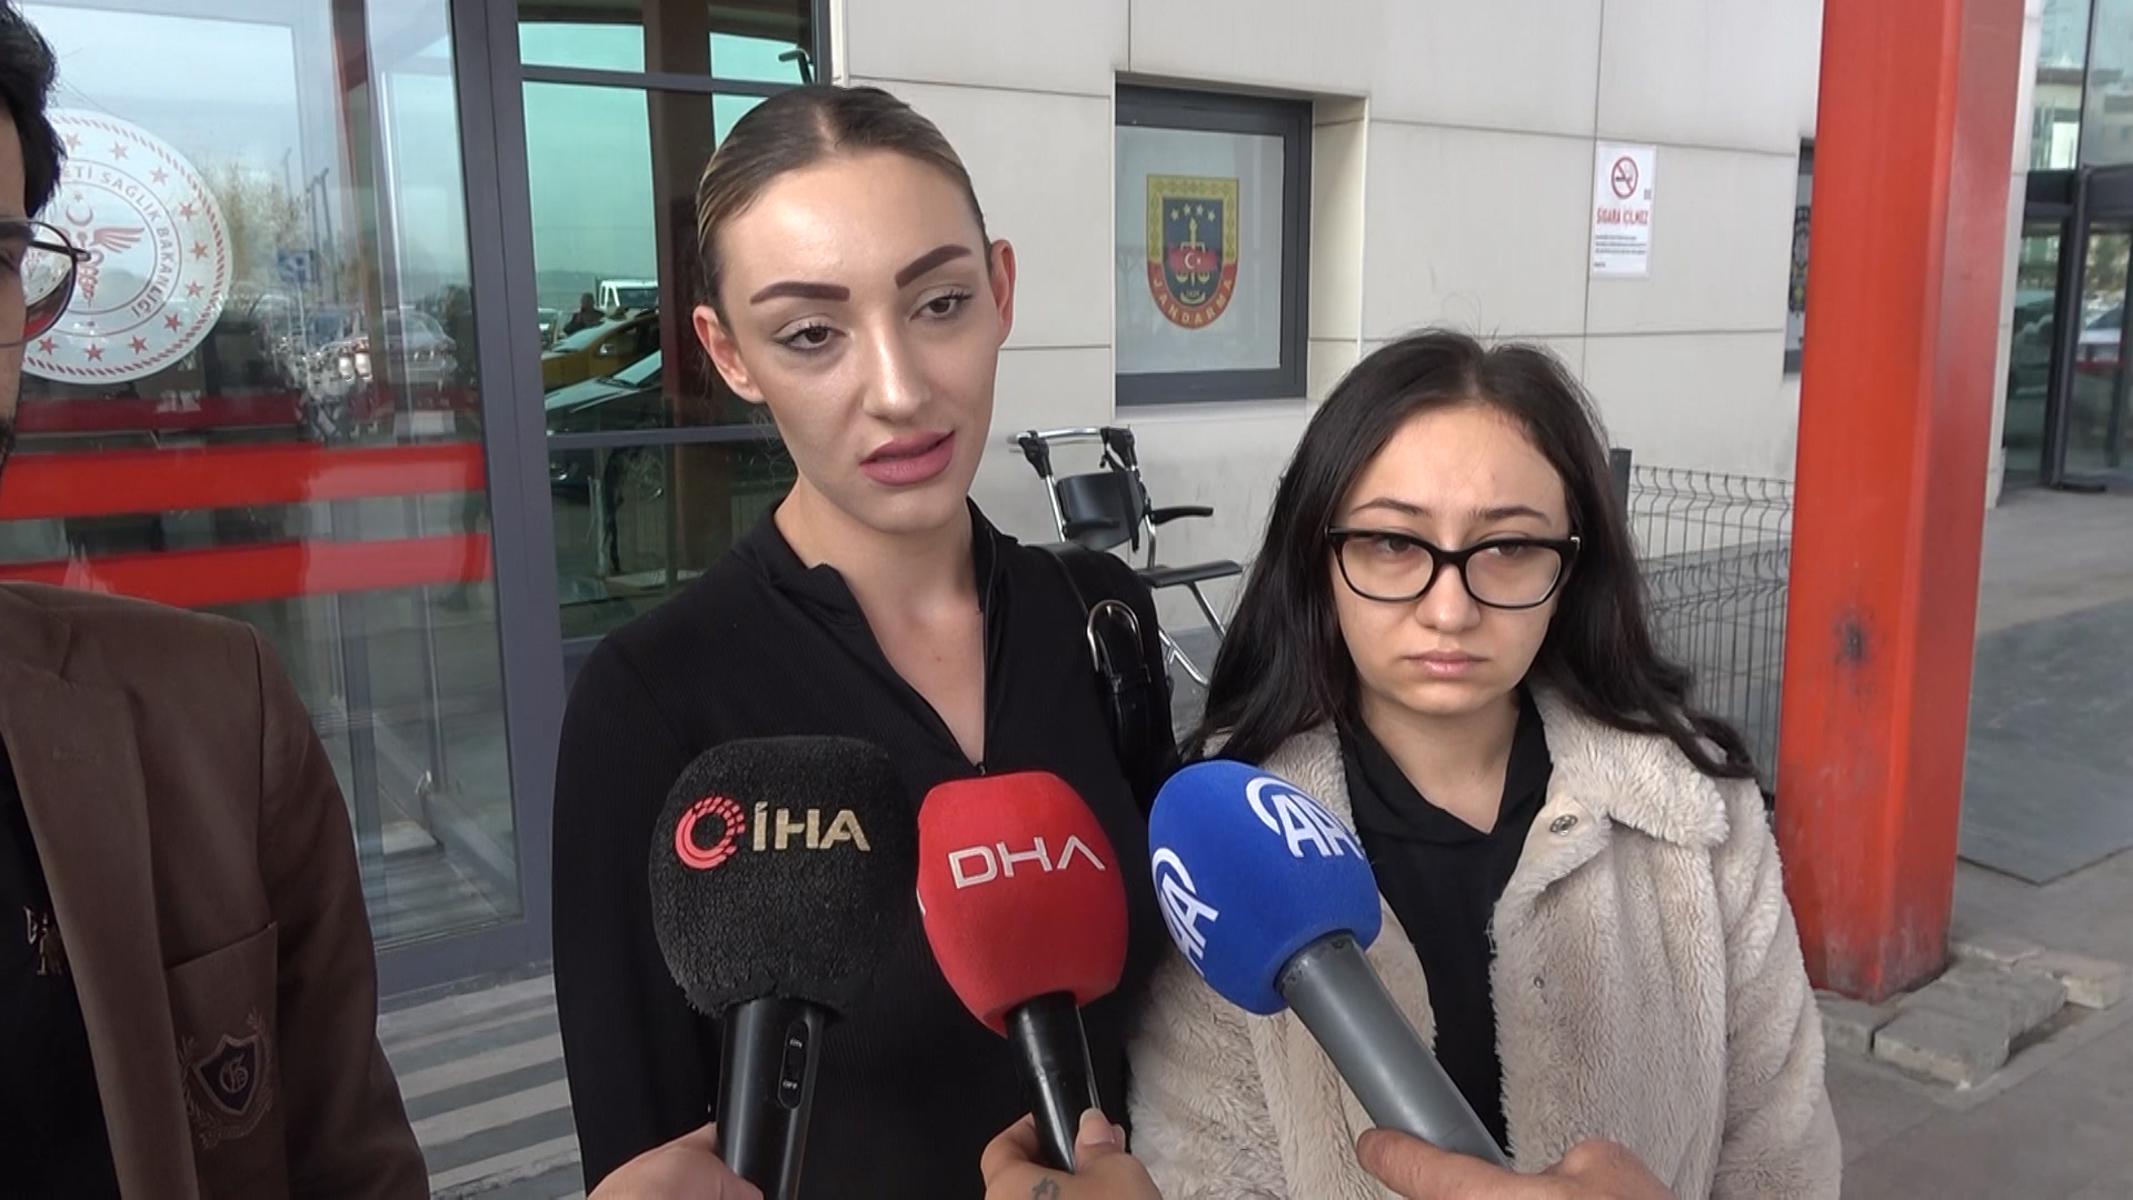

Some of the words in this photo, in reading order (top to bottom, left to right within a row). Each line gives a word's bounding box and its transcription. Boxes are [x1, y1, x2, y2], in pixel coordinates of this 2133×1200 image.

[102, 172, 161, 222] SAĞLIK
[131, 227, 174, 318] BAKANLIĞI
[1153, 279, 1233, 325] JANDARMA
[753, 800, 871, 852] İHA
[1271, 793, 1364, 860] AA
[947, 836, 1105, 889] DHA
